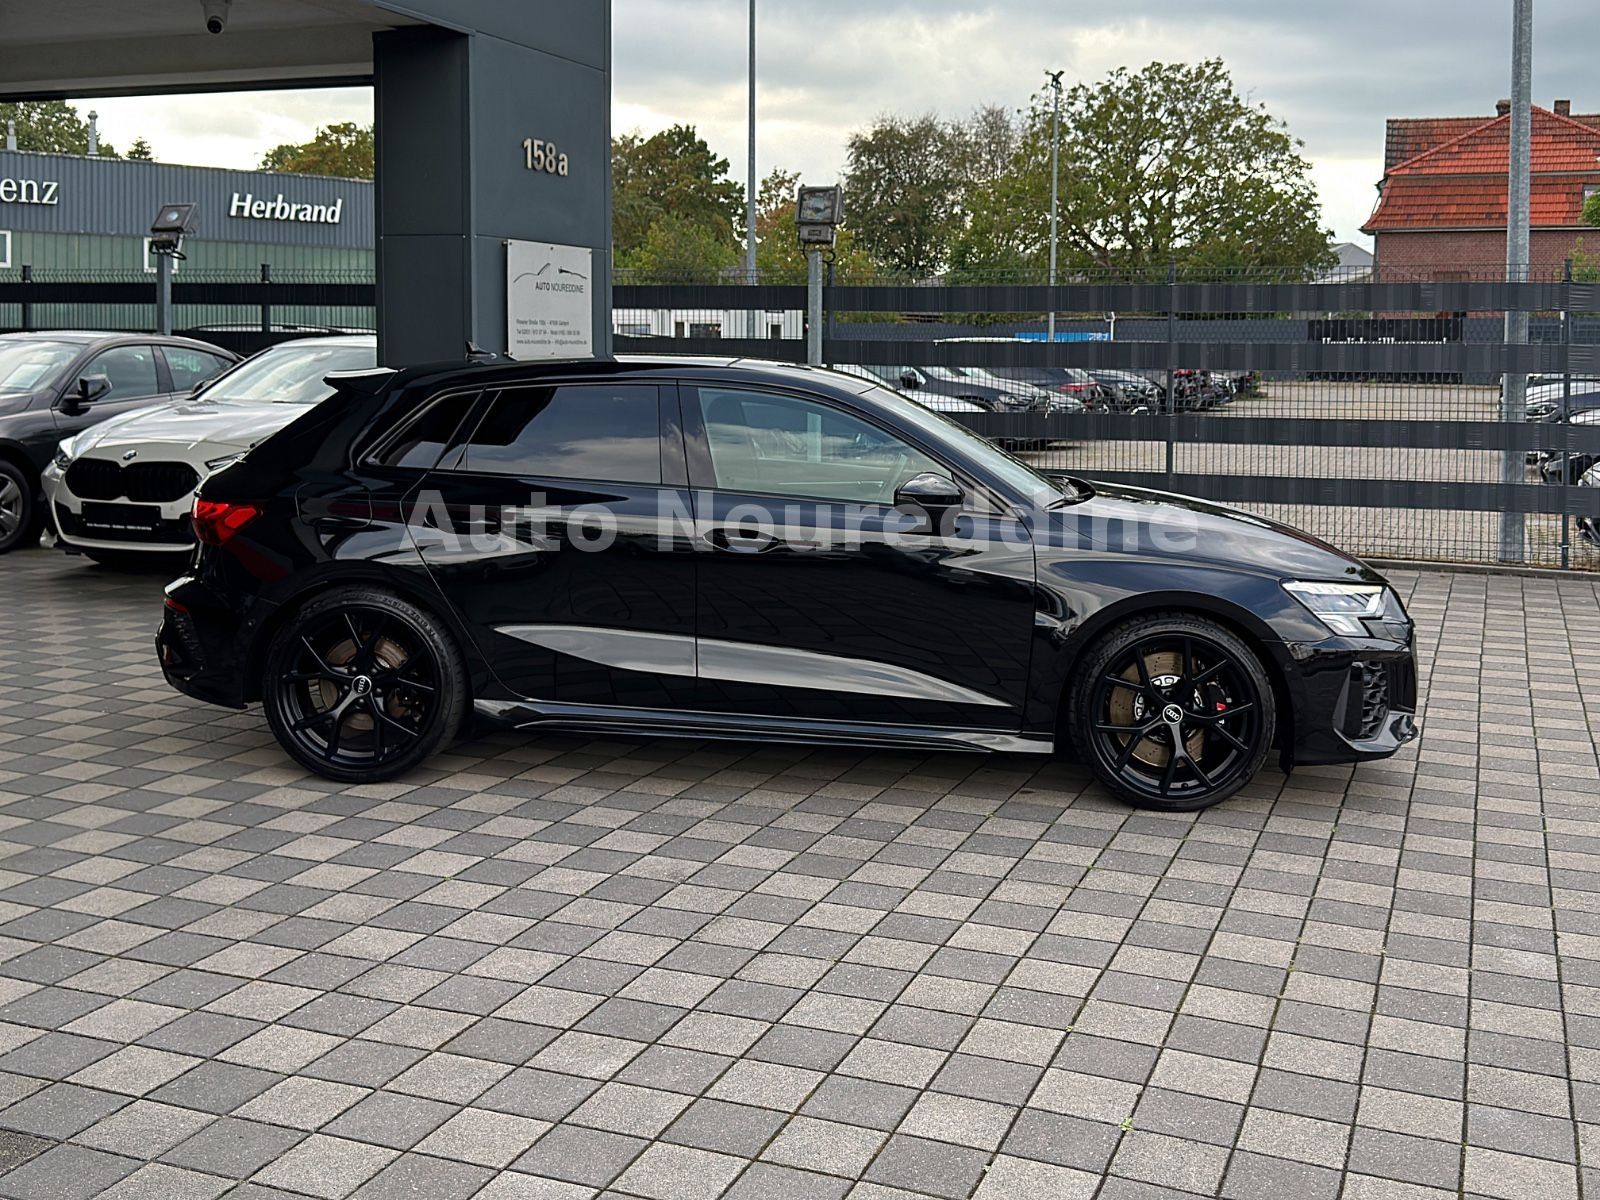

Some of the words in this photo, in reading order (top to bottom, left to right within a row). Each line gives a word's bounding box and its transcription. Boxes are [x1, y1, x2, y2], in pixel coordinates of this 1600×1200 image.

[523, 138, 568, 176] 158a
[0, 178, 59, 205] enz
[229, 192, 343, 224] Herbrand
[535, 281, 550, 291] AUTO
[550, 282, 584, 294] NOUREDDINE
